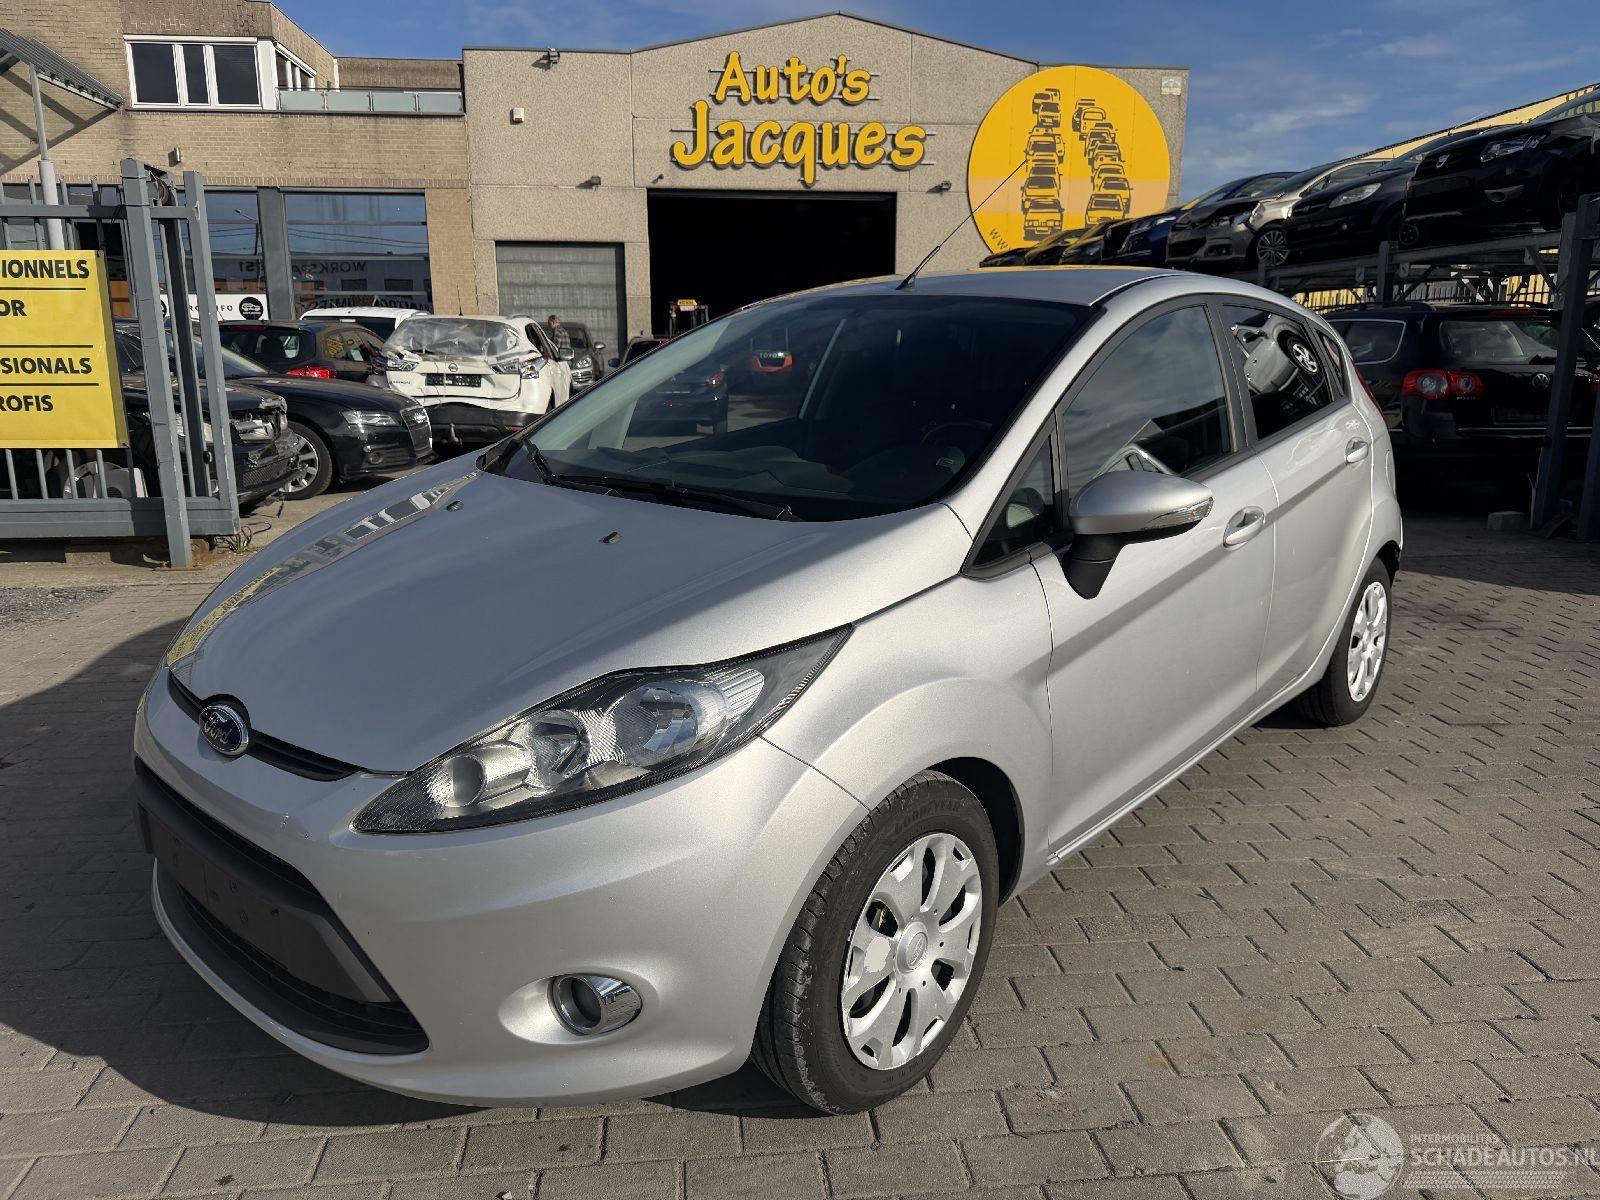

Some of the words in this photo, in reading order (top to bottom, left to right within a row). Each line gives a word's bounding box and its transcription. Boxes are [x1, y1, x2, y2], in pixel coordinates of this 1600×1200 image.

[714, 51, 872, 104] Auto's
[671, 99, 928, 187] Jacques
[1, 259, 90, 279] IONNELS
[0, 298, 28, 317] OR
[0, 357, 93, 375] SIONALS
[204, 711, 232, 744] Ford
